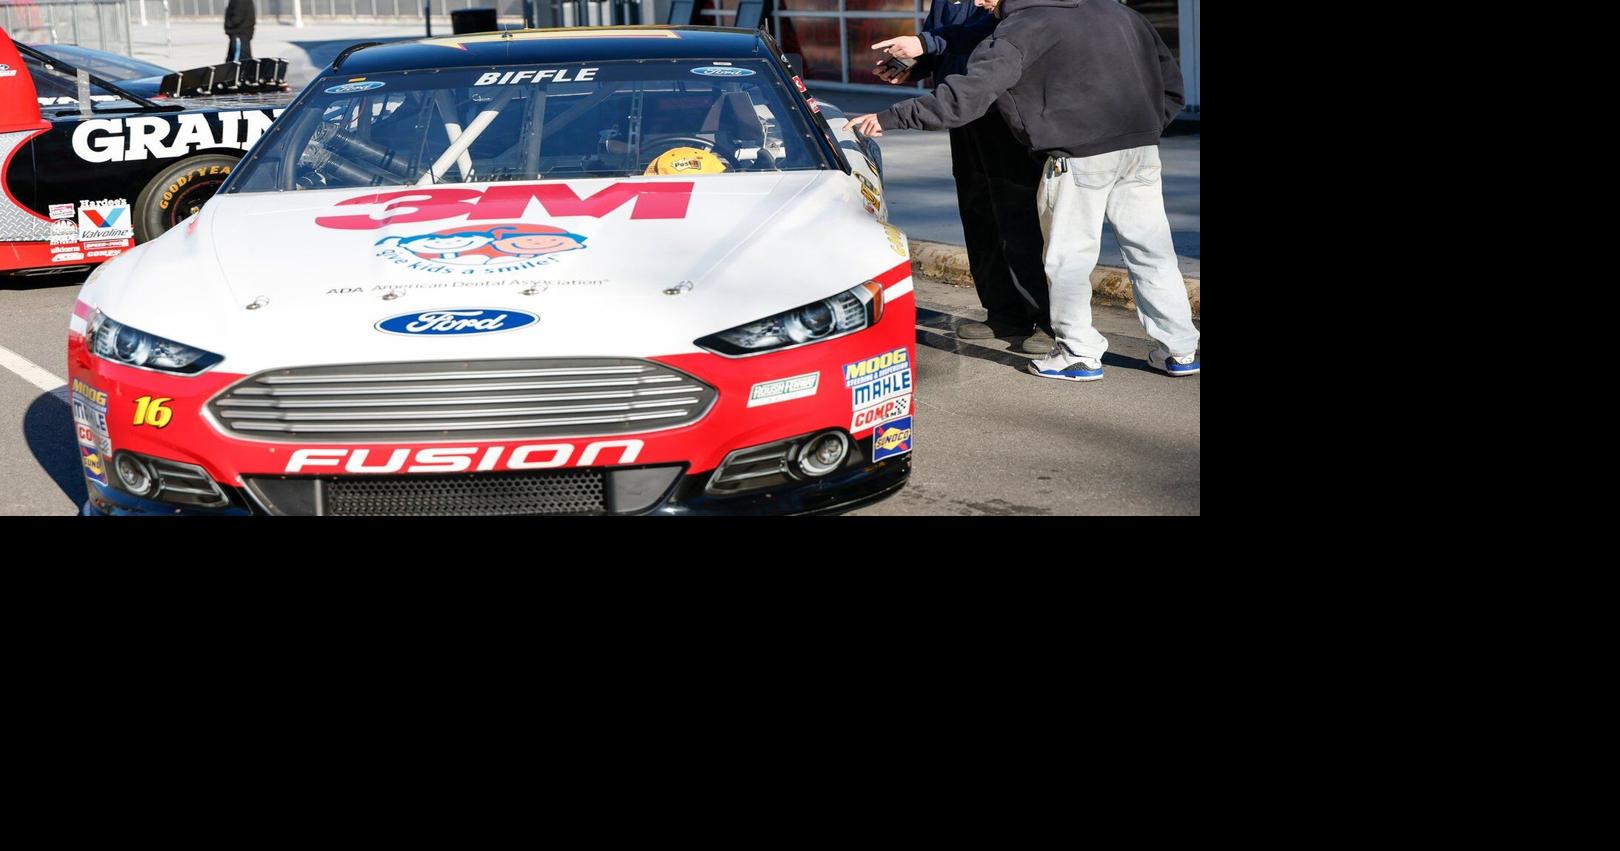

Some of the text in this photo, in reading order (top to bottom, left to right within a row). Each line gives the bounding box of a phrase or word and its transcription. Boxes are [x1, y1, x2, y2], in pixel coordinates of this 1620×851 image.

[473, 67, 600, 86] BIFFLE
[703, 66, 742, 77] Ford
[80, 197, 127, 208] Hardee's
[314, 181, 695, 231] 3M
[81, 229, 129, 239] Valvoline
[376, 249, 408, 265] give
[408, 261, 453, 274] kids
[461, 267, 475, 275] a
[325, 286, 364, 295] ADA
[371, 281, 448, 292] American
[452, 279, 506, 289] Dental
[405, 310, 508, 332] Ford
[845, 347, 908, 380] MOOG
[854, 370, 911, 405] MAHLE
[132, 395, 175, 429] 16
[854, 402, 895, 428] COMP
[875, 429, 911, 449] SUNOCO
[284, 438, 645, 474] FUSION
